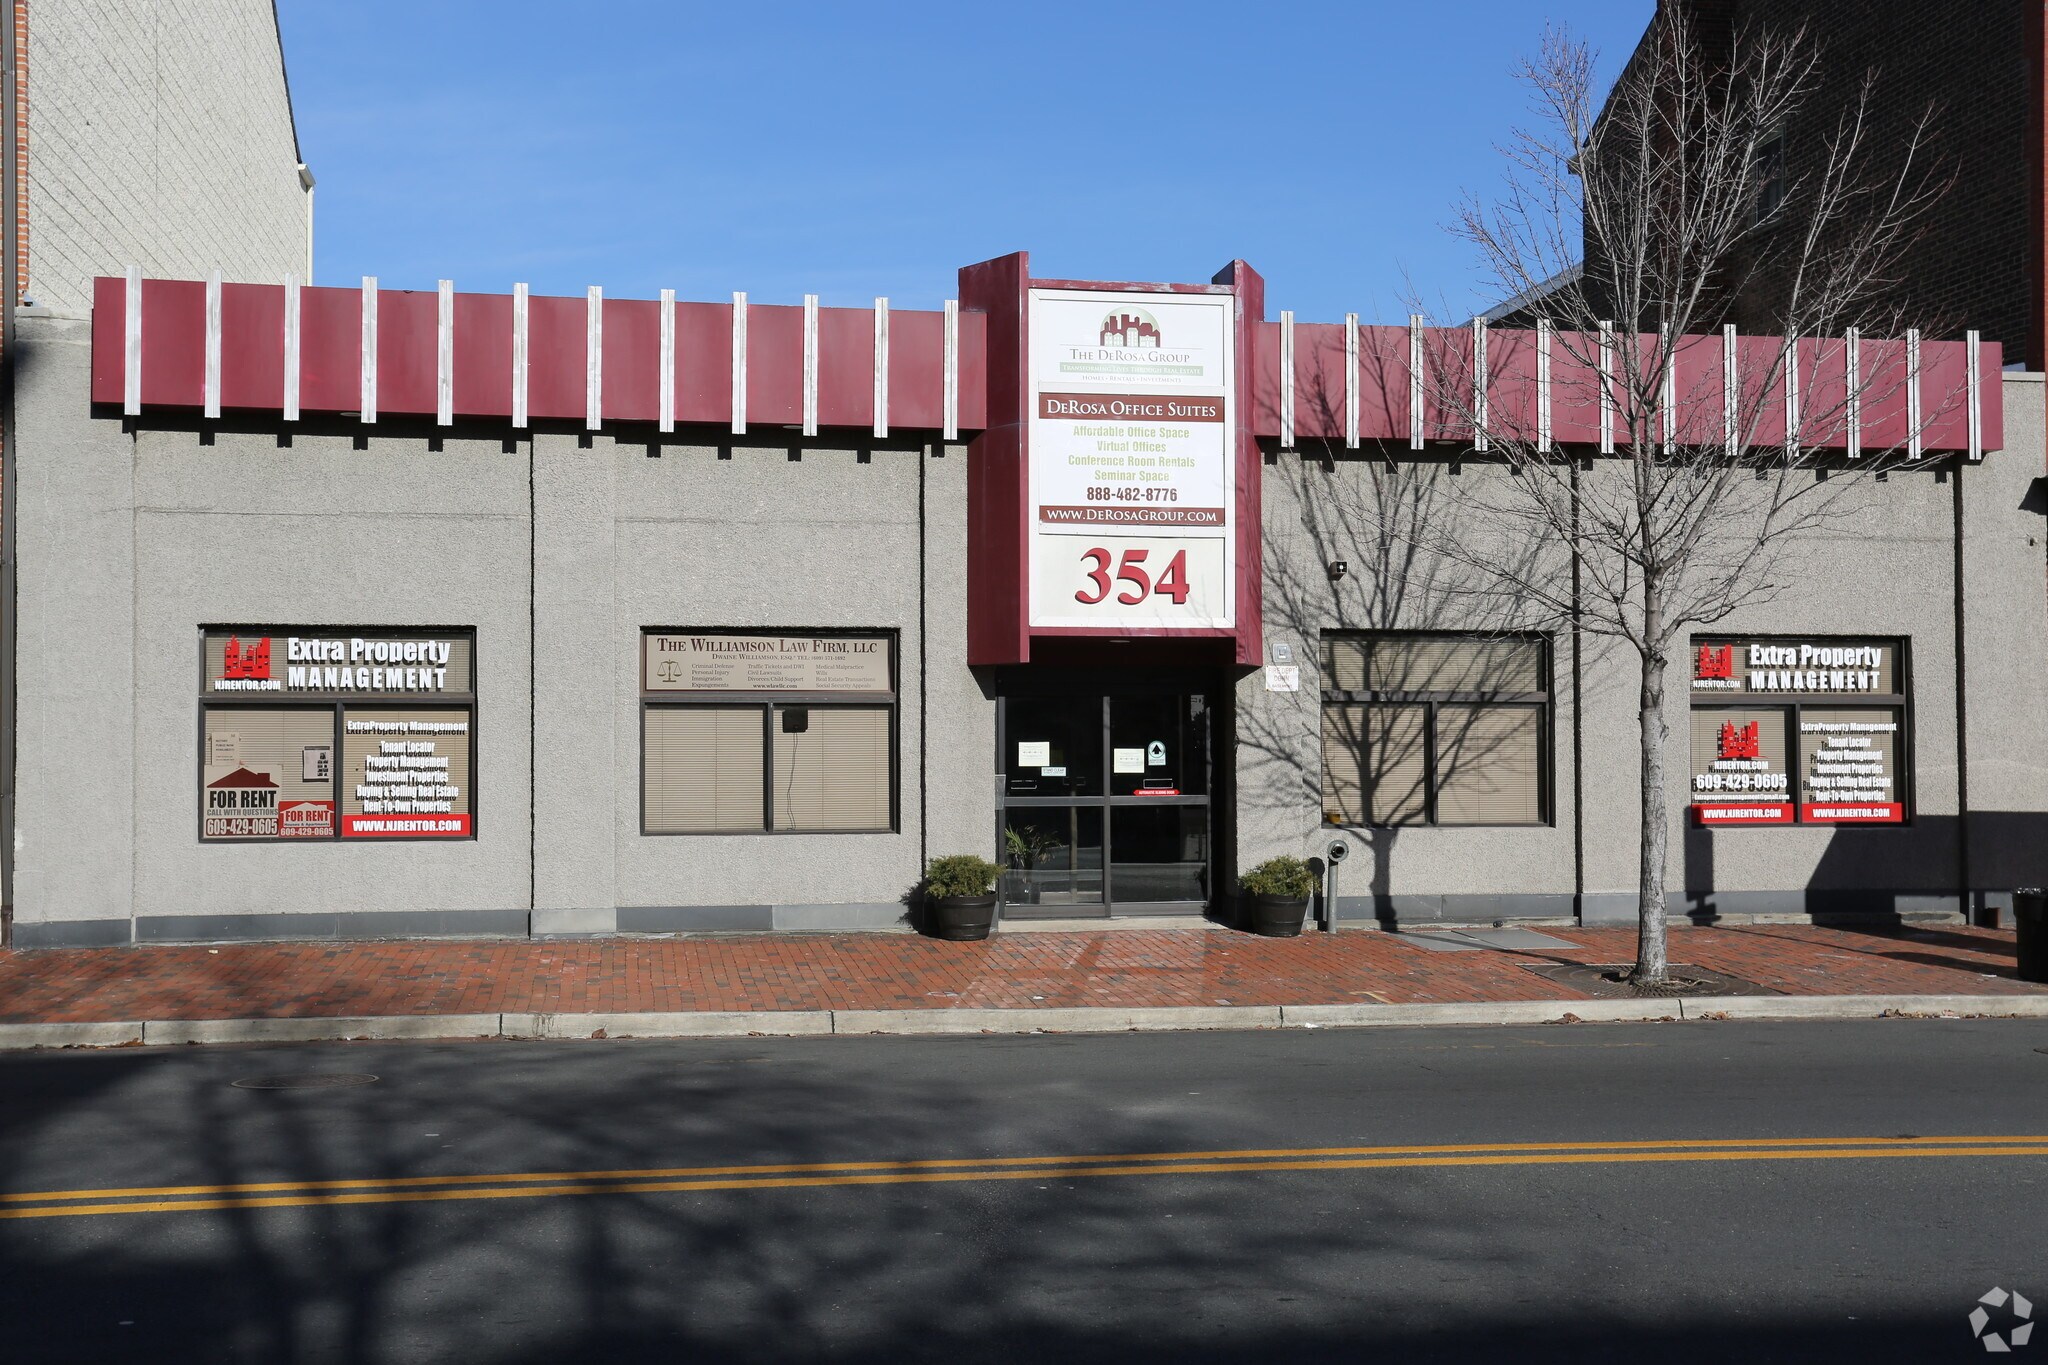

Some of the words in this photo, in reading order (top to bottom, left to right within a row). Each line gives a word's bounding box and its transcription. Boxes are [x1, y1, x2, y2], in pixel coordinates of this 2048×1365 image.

[1148, 351, 1190, 363] GROUP
[1111, 401, 1163, 416] OFFICE
[1168, 402, 1216, 417] SUITES
[1073, 426, 1124, 437] Affordable
[1127, 427, 1156, 438] Office
[1159, 427, 1190, 440] Space
[1097, 441, 1130, 452] Virtual
[1132, 441, 1167, 452] Offices
[1068, 455, 1124, 466] Conference
[1128, 456, 1156, 467] Room
[1159, 457, 1195, 468] Rentals
[1094, 470, 1136, 481] Seminar
[1139, 470, 1170, 483] Space
[1087, 487, 1178, 501] 888-482-8776
[1074, 547, 1190, 605] 354
[288, 637, 344, 661] Extra
[350, 638, 450, 664] Property
[657, 638, 687, 652] THE
[690, 638, 775, 652] WILLIAMSON
[779, 639, 808, 652] LAW
[854, 642, 877, 653] LLC
[1751, 644, 1797, 666] Extra
[1801, 645, 1882, 668] Property
[288, 667, 447, 688] MANAGEMENT
[1752, 671, 1880, 689] MANAGEMENT
[214, 680, 281, 691] NJRENTOR.COM
[1693, 680, 1741, 688] NJRENTOR.COM
[347, 721, 408, 731] ExtraProperty
[409, 722, 468, 732] Management
[1801, 722, 1850, 731] ExtraProperty
[1850, 723, 1897, 731] Management
[381, 741, 406, 752] Tenant
[407, 741, 435, 752] Locator
[1828, 737, 1848, 747] Tenant
[1849, 737, 1871, 747] Locator
[366, 755, 399, 768] Property
[400, 756, 449, 768] Management
[1817, 750, 1842, 762] Property
[1843, 750, 1883, 761] Management
[1714, 761, 1769, 770] NJRENTOR.COM
[1817, 763, 1851, 773] Investment
[1851, 763, 1883, 775] Properties
[366, 770, 409, 782] Investment
[410, 770, 449, 783] Properties
[1696, 774, 1788, 789] 609-429-0605
[1809, 776, 1830, 788] Buying
[1837, 776, 1858, 788] Selling
[1859, 777, 1873, 787] Real
[1873, 777, 1891, 788] Estate
[357, 785, 383, 798] Buying
[384, 786, 389, 796] &
[391, 785, 417, 798] Selling
[418, 786, 435, 796] Real
[436, 786, 459, 797] Estate
[1816, 790, 1854, 801] Rent-To-Own
[1854, 790, 1885, 802] Properties
[209, 790, 237, 808] FOR
[241, 790, 277, 808] RENT
[364, 800, 412, 812] Rent-To-Own
[412, 800, 452, 813] Properties
[286, 811, 303, 821] FOR
[306, 811, 330, 821] RENT
[1703, 809, 1782, 819] WWW.NJRENTOR.COM
[1813, 808, 1890, 818] WWW.NJRENTOR.COM
[207, 819, 278, 835] 609-429-0605
[280, 828, 334, 836] 609-429-0605
[352, 820, 462, 832] WWW.NJRENTOR.COM
